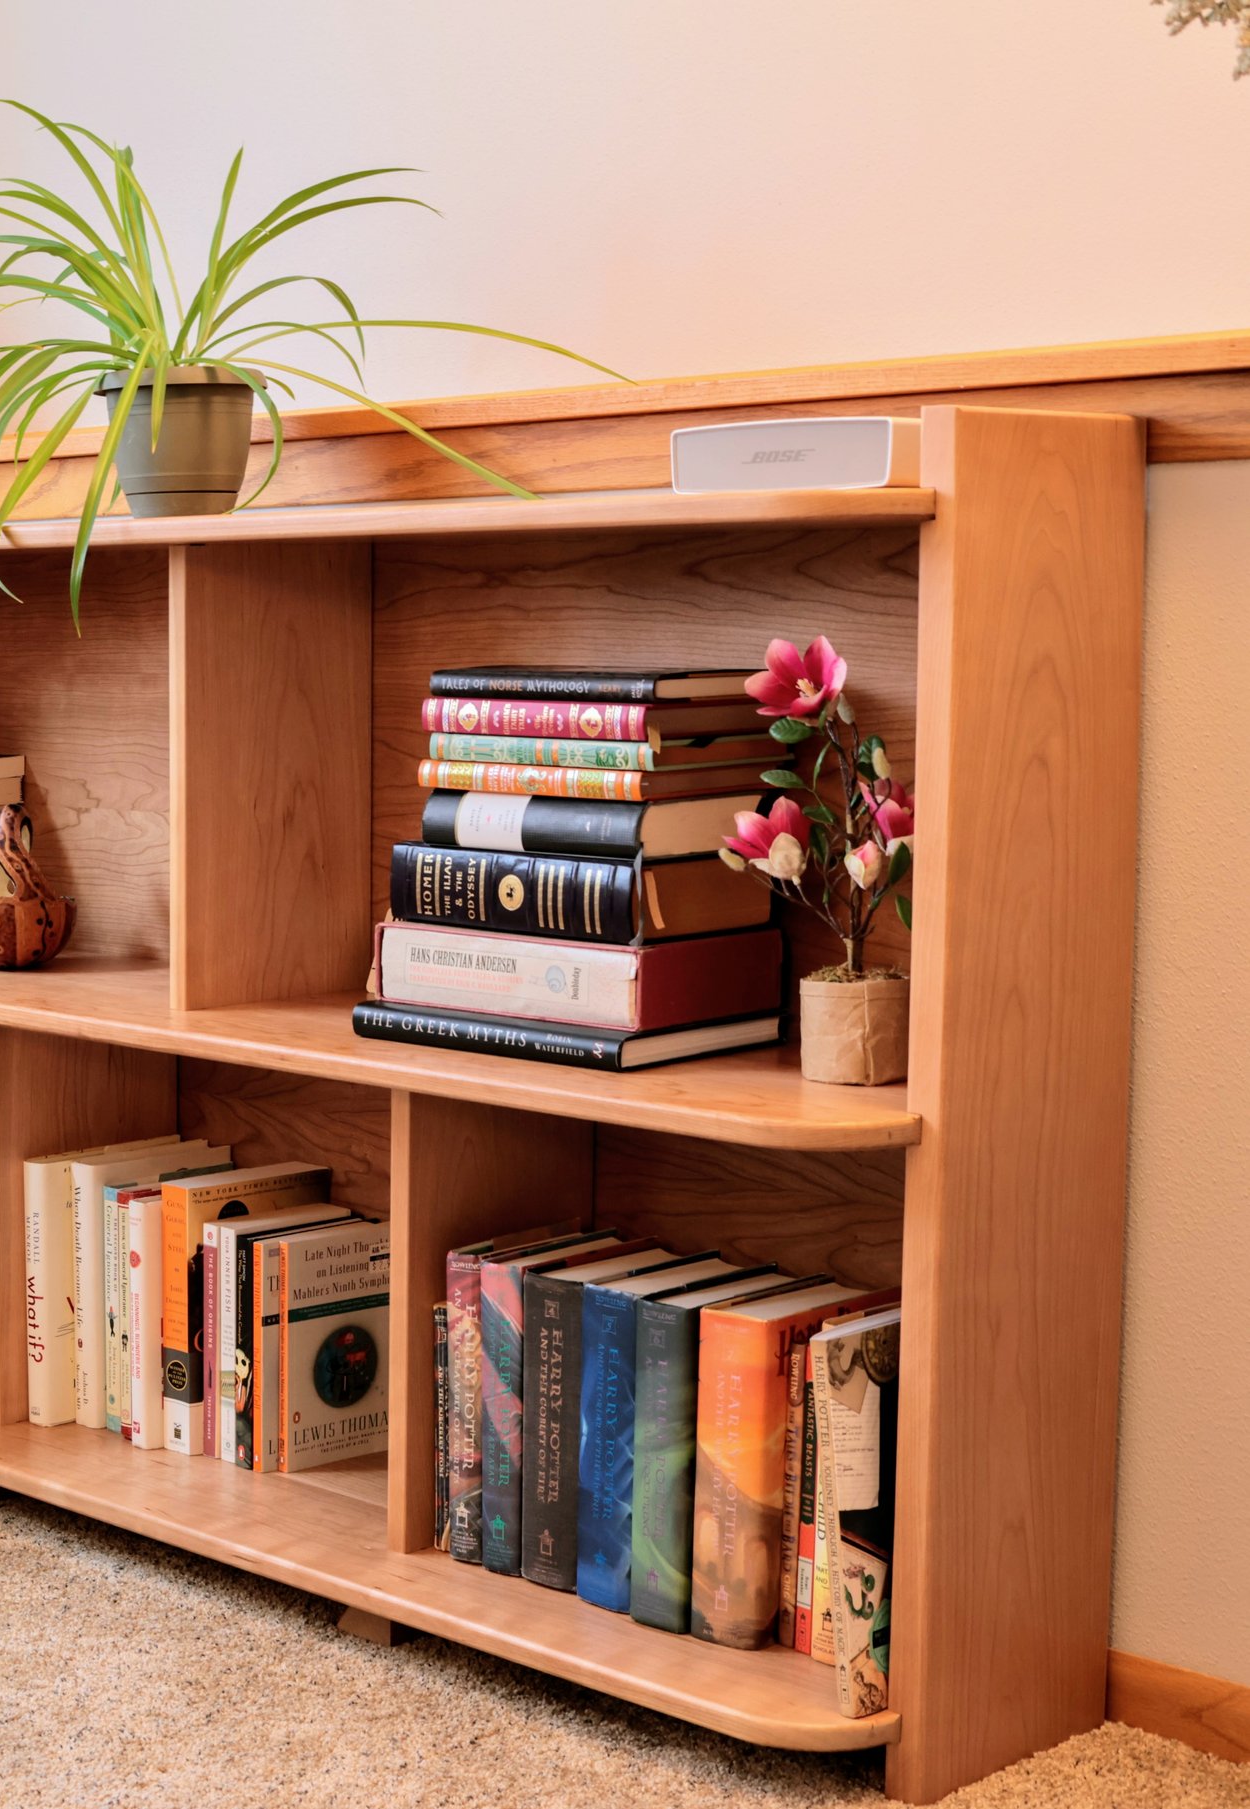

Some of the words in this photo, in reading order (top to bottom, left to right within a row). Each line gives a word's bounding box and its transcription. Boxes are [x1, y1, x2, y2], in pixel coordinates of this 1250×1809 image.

[742, 449, 814, 464] BOSE
[441, 678, 469, 690] TALES
[473, 679, 485, 690] OF
[489, 680, 523, 691] NORSE
[526, 679, 591, 693] MYTHOLOGY
[502, 704, 511, 735] GRIMM'S
[511, 709, 519, 731] FAIRY
[518, 708, 527, 732] TALES
[424, 853, 434, 916] HOMER
[445, 856, 453, 892] ILIAD
[467, 858, 478, 920] ODYSSEY
[456, 898, 463, 907] &
[410, 947, 430, 963] HANS
[432, 949, 473, 969] CHRISTIAN
[475, 954, 517, 974] ANDERSEN
[571, 967, 581, 1000] Doubleday
[362, 1011, 394, 1028] THE
[401, 1016, 459, 1038] GREEK
[466, 1026, 527, 1047] MYTHS
[545, 1033, 572, 1044] ROBIN
[534, 1042, 585, 1057] WATERFIELD
[192, 1191, 211, 1199] NEW
[217, 1186, 238, 1194] YORK
[244, 1181, 269, 1190] TIMES
[32, 1212, 40, 1264] RANDALL
[305, 1250, 324, 1261] Late
[327, 1245, 350, 1259] Night
[317, 1269, 326, 1278] on
[330, 1262, 369, 1276] Listening
[332, 1281, 356, 1293] Ninth
[27, 1276, 44, 1329] what
[29, 1336, 45, 1363] if?
[464, 1304, 478, 1384] HARRY
[499, 1320, 512, 1396] HARRY
[540, 1328, 548, 1360] AND
[550, 1328, 563, 1412] HARRY
[605, 1347, 619, 1427] HARRY
[790, 1353, 800, 1400] ROWLING
[815, 1355, 827, 1396] HARRY
[294, 1422, 335, 1446] LEWIS
[340, 1410, 388, 1435] THOMA
[463, 1391, 475, 1470] POTTER
[539, 1398, 547, 1443] GOBLET
[806, 1388, 815, 1438] FANTASTIC
[498, 1408, 510, 1487] POTTER
[538, 1450, 546, 1465] OF
[548, 1422, 560, 1502] POTTER
[538, 1472, 546, 1502] FIRE
[603, 1438, 615, 1519] POTTER
[824, 1464, 833, 1507] JOURNEY
[827, 1512, 838, 1558] THROUGH
[833, 1568, 842, 1609] HISTORY
[836, 1612, 842, 1622] OF
[837, 1626, 845, 1656] MAGIC
